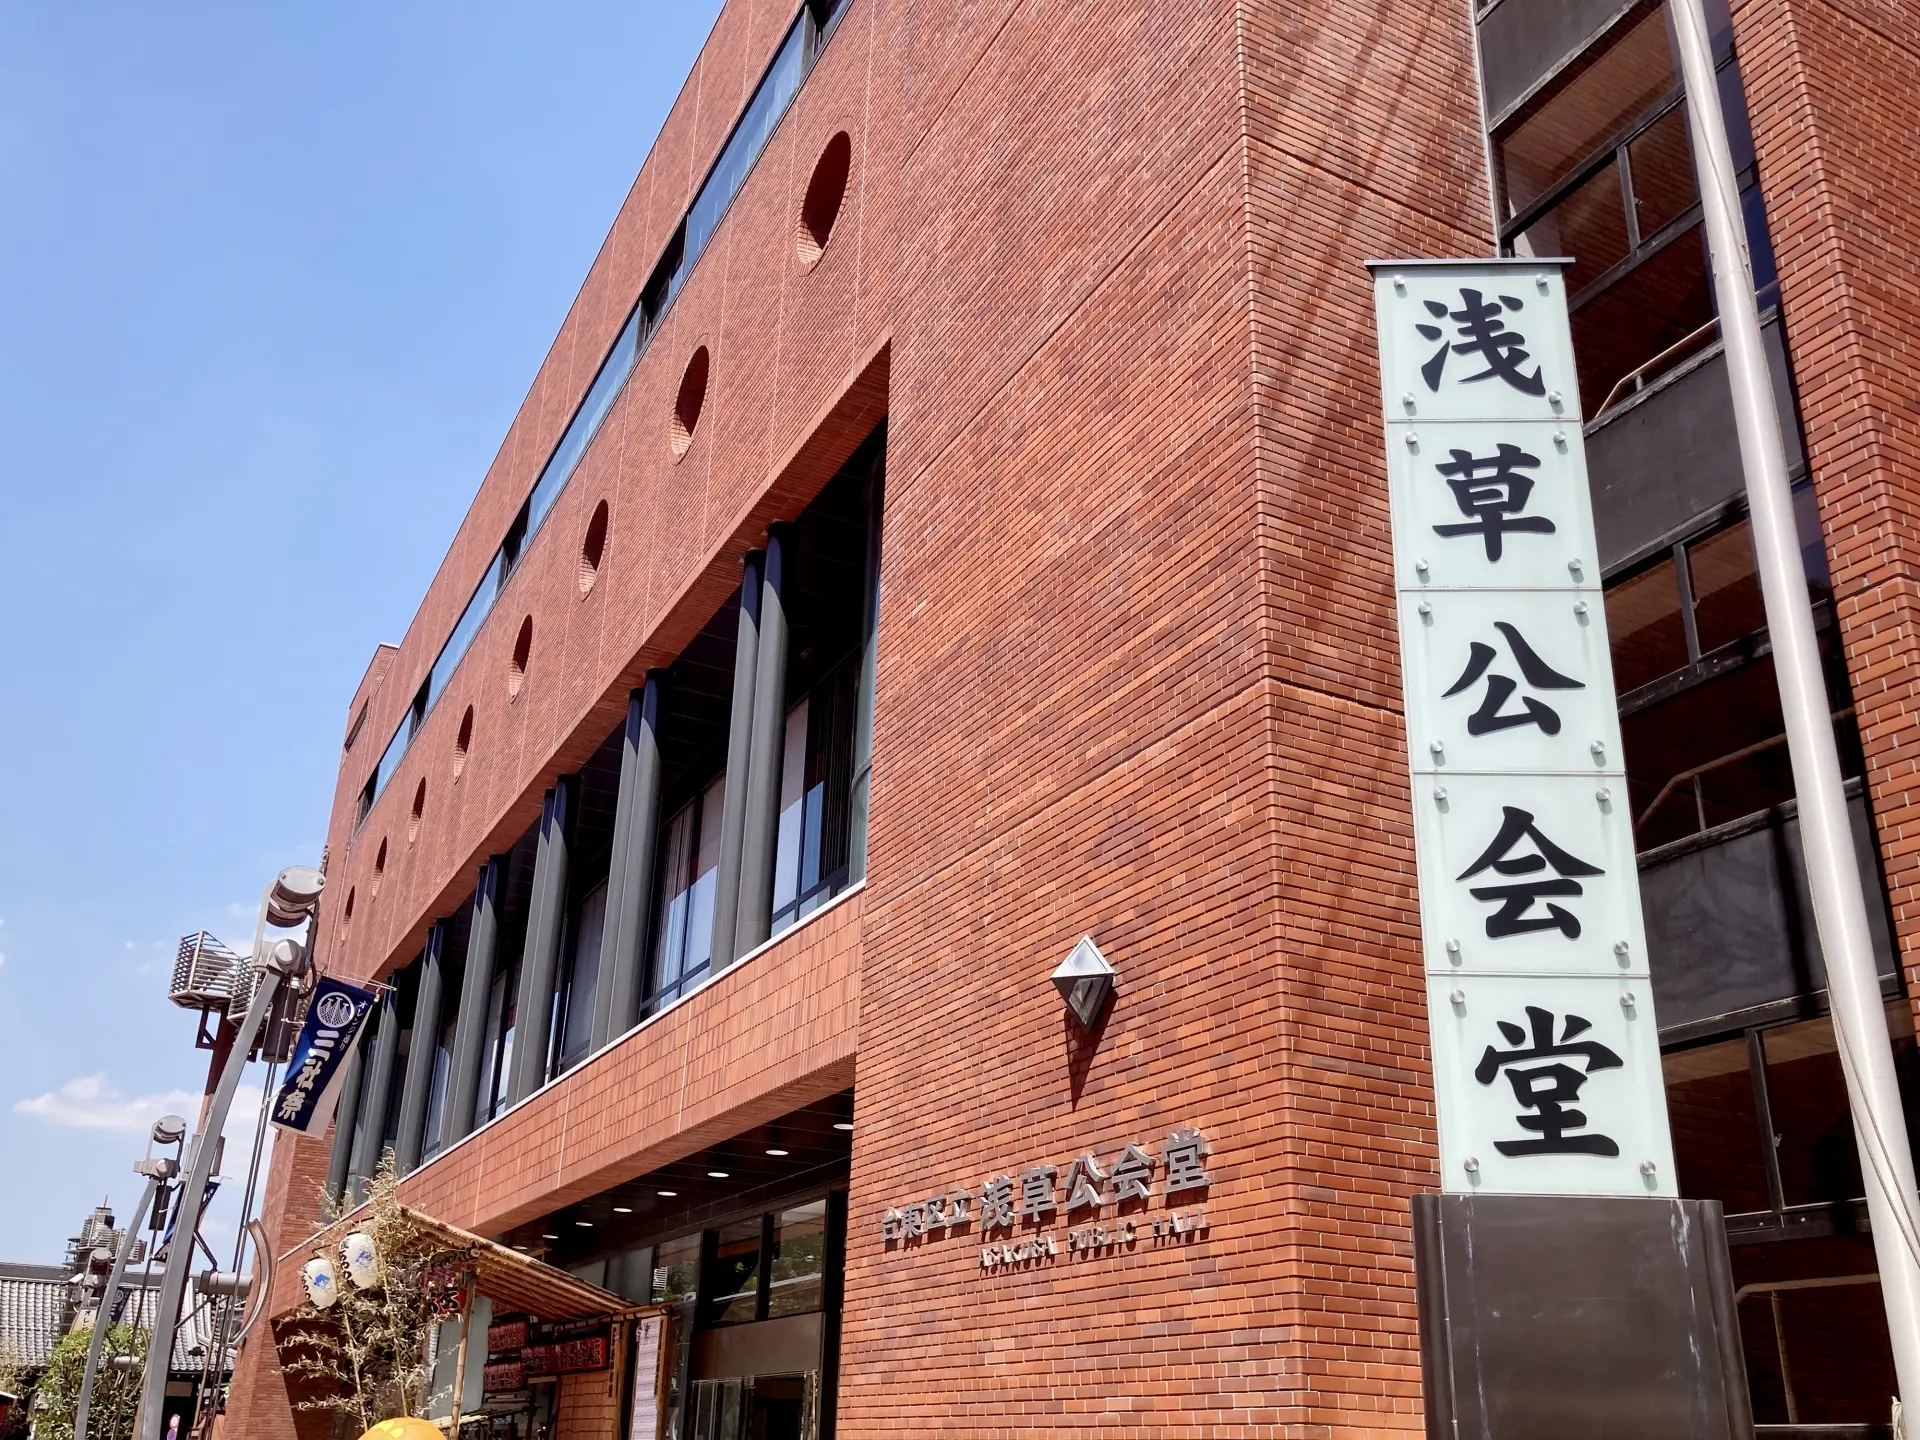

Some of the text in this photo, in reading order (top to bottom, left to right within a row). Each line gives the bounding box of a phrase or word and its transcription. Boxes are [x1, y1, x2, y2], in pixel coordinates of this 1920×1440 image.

[1415, 288, 1623, 1158] 浅草公会堂
[277, 1029, 341, 1122] 三社祭
[882, 1127, 1211, 1242] 台東区立 浅草公会堂
[979, 1207, 1211, 1267] ASAKUSA PUBLIC HALL
